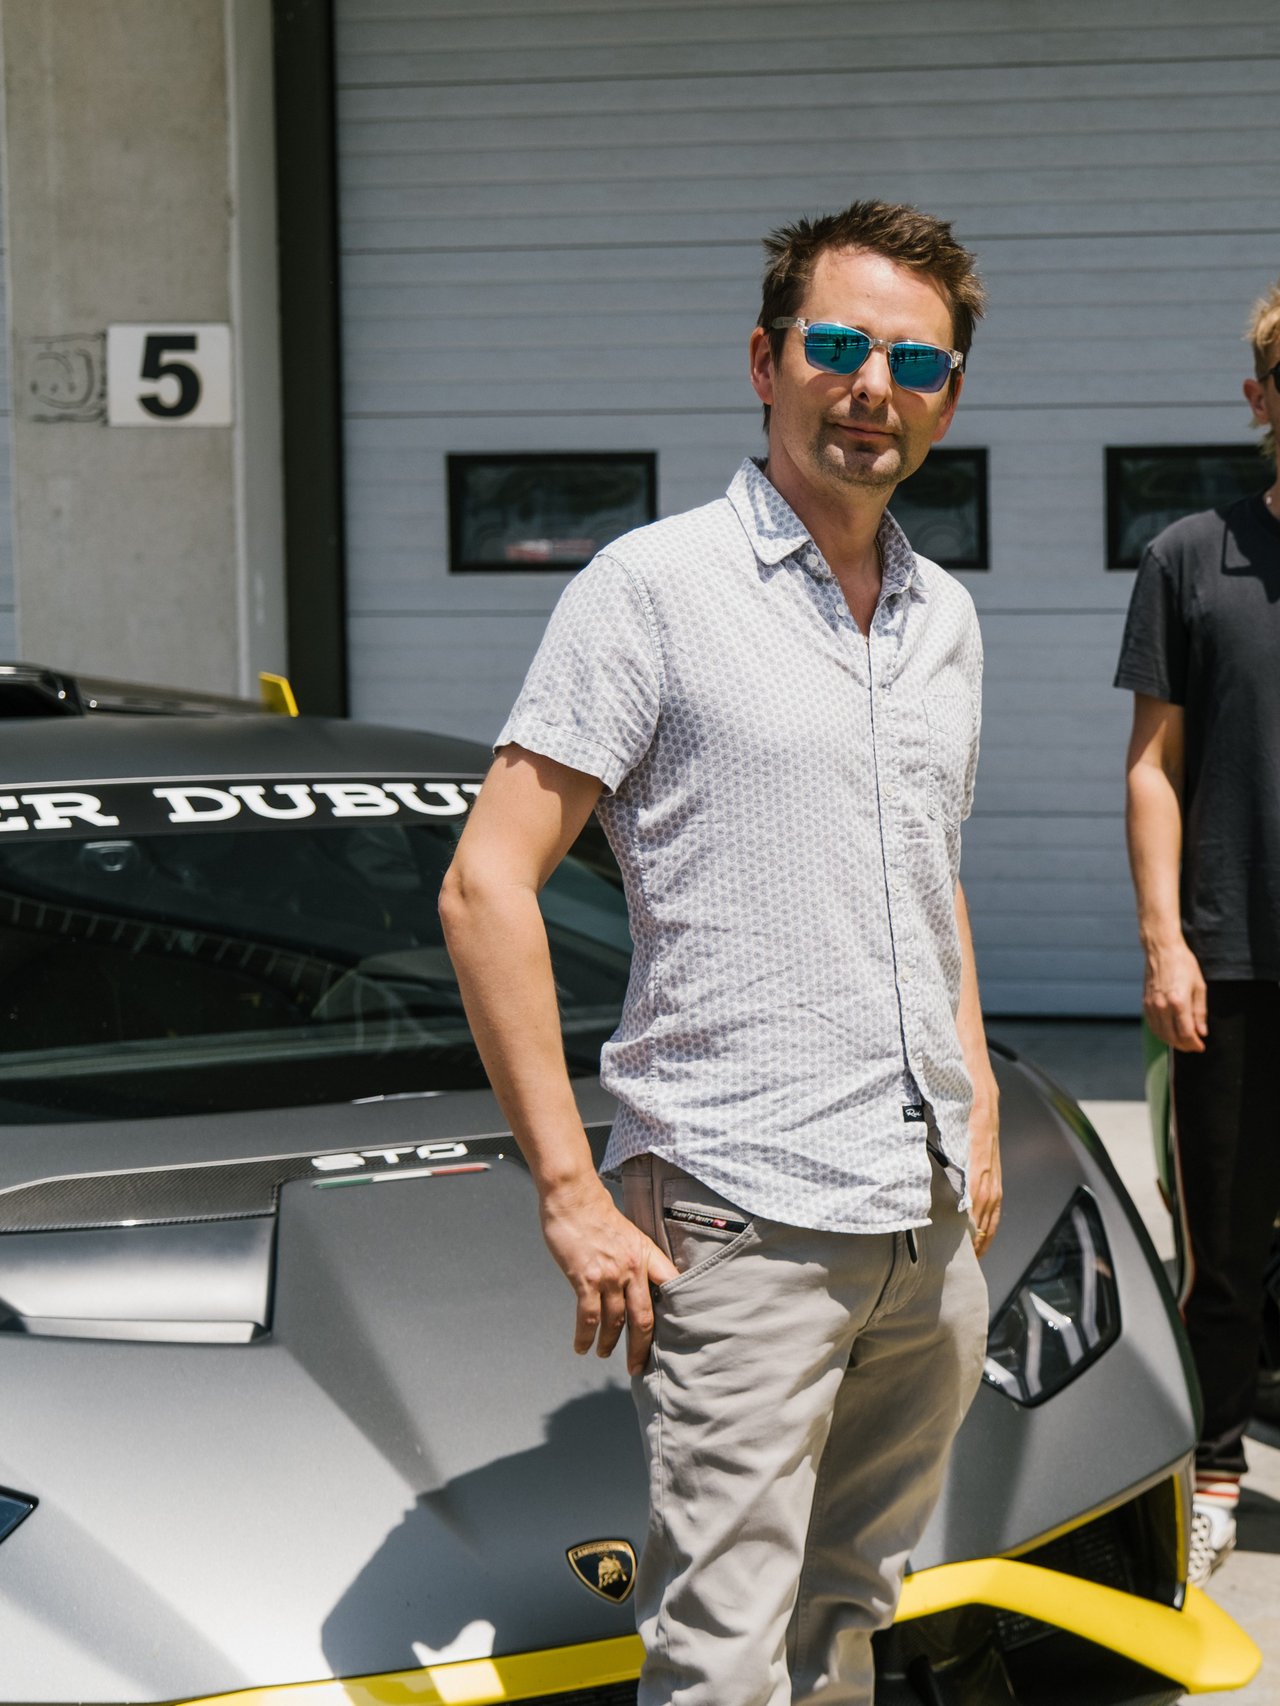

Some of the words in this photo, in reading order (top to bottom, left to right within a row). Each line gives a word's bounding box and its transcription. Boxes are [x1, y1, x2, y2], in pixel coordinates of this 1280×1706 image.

[138, 333, 202, 419] 5
[152, 782, 483, 823] DUBU
[311, 1142, 468, 1171] STO
